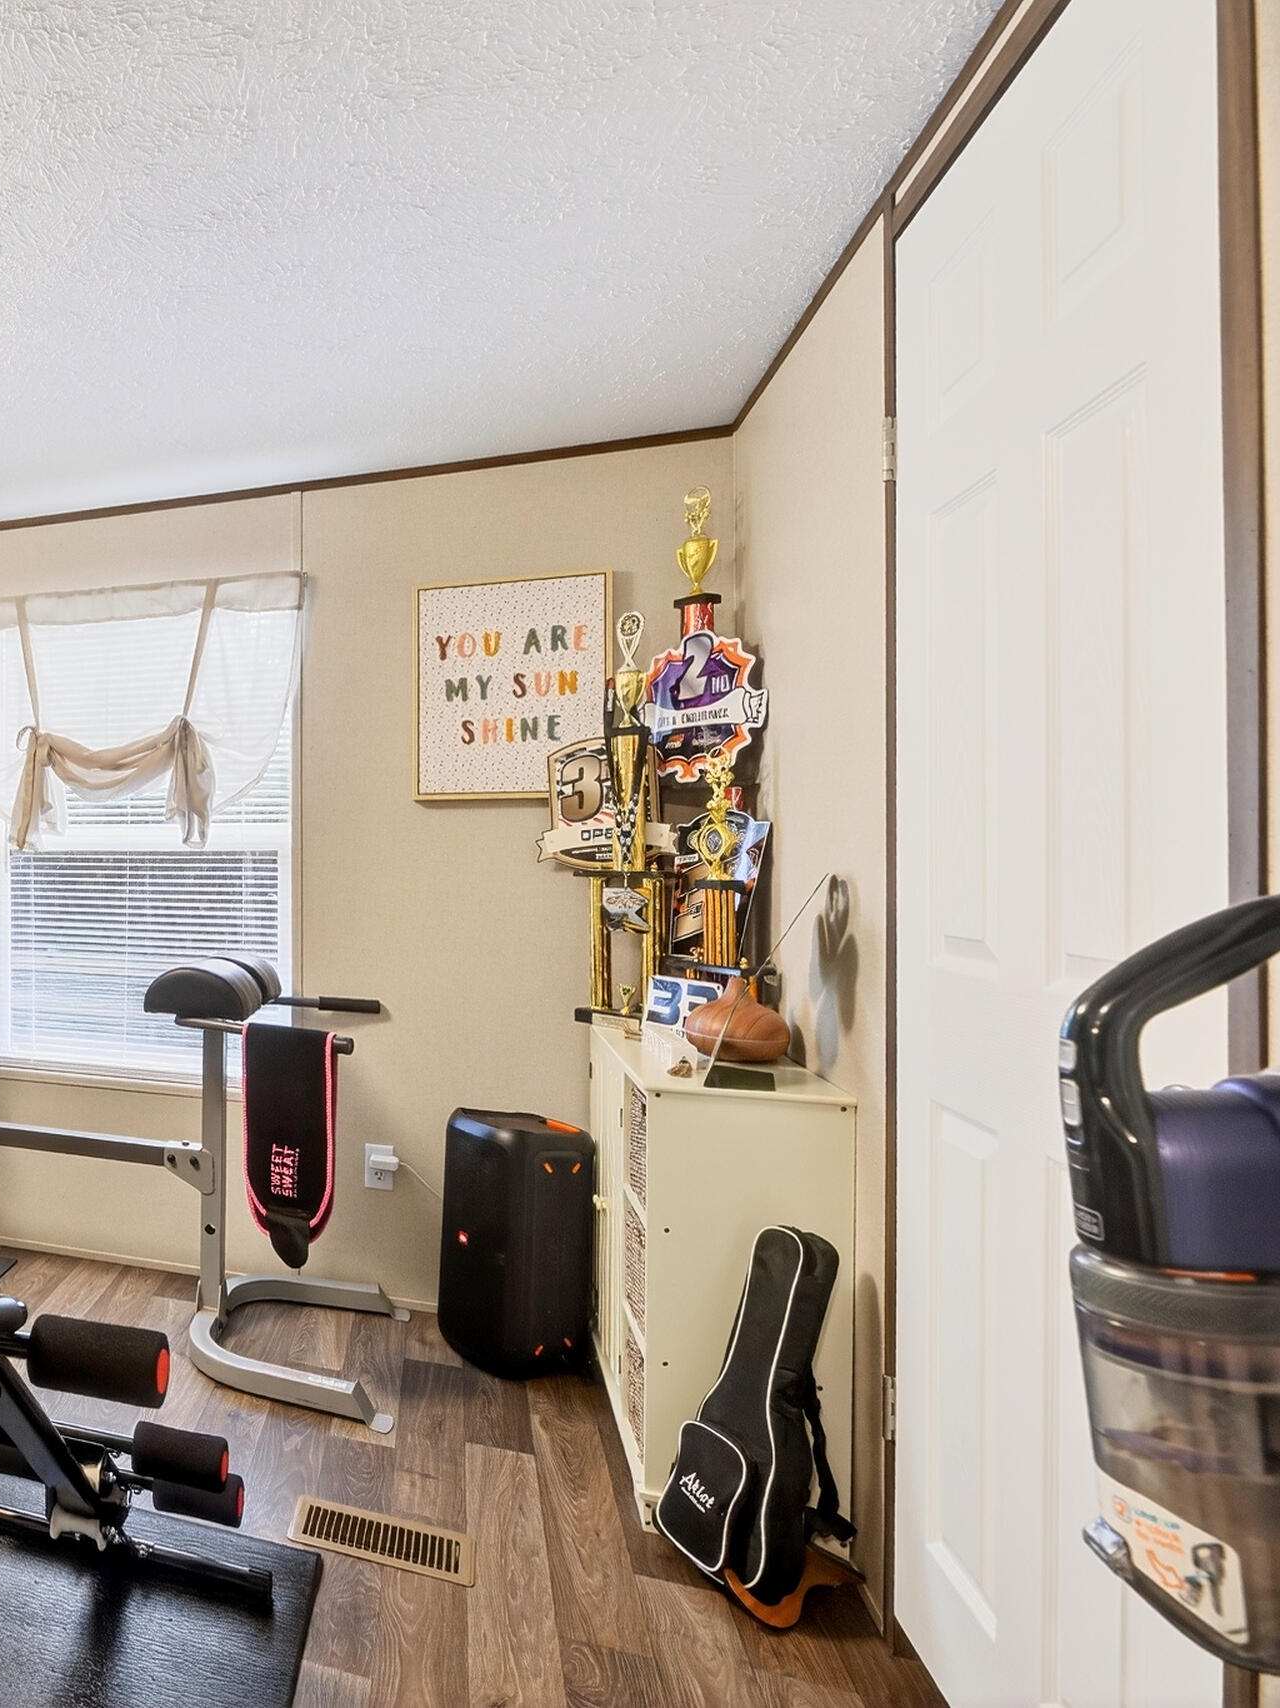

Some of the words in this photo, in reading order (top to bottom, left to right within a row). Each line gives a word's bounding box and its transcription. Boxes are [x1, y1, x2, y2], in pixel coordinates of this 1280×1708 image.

[435, 631, 502, 661] YOU
[523, 624, 588, 655] ARE
[445, 675, 492, 702] MY
[512, 670, 579, 699] SUN
[461, 715, 561, 745] SHINE
[270, 1143, 283, 1195] SWEET
[282, 1145, 294, 1197] SWEAT
